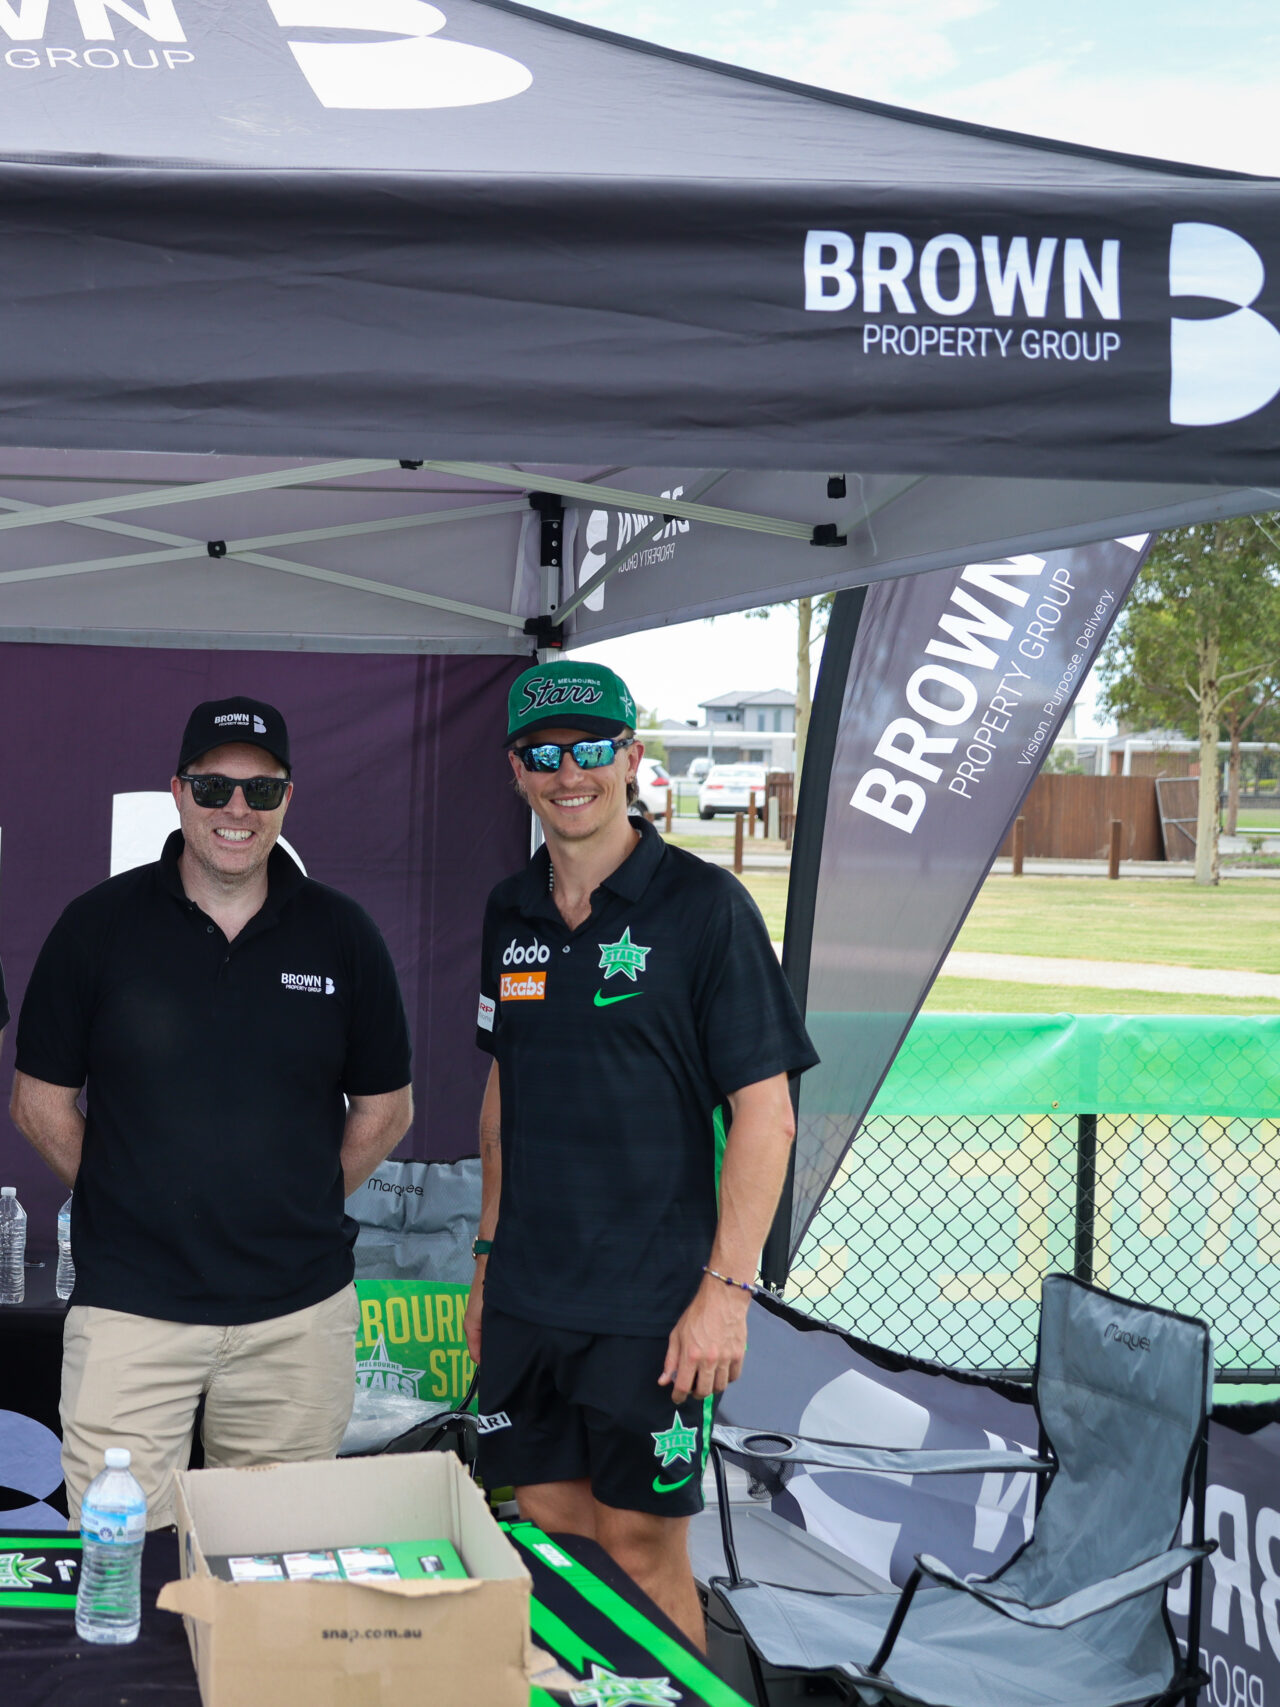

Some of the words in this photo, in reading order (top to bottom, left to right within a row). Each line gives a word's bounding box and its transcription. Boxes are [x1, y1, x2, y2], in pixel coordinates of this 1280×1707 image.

[4, 47, 195, 70] GROUP
[803, 230, 1120, 319] BROWN
[863, 324, 1014, 357] PROPERTY
[1020, 330, 1120, 361] GROUP
[557, 678, 601, 686] MELBOURNE
[948, 661, 1031, 799] PROPERTY
[1018, 568, 1075, 660] GROUP
[1017, 720, 1052, 766] Vision.
[1043, 653, 1084, 716] Purpose.
[1076, 589, 1115, 649] Delivery.
[518, 677, 603, 716] Stars
[849, 554, 1047, 834] BROWN
[214, 713, 250, 724] BROWN
[502, 936, 550, 966] dodo
[603, 951, 642, 964] STARS
[281, 972, 322, 987] BROWN
[500, 976, 545, 998] 13cabs
[358, 1361, 401, 1371] MELBOURNE
[357, 1371, 415, 1399] TARS
[321, 1627, 423, 1643] snap.com.au
